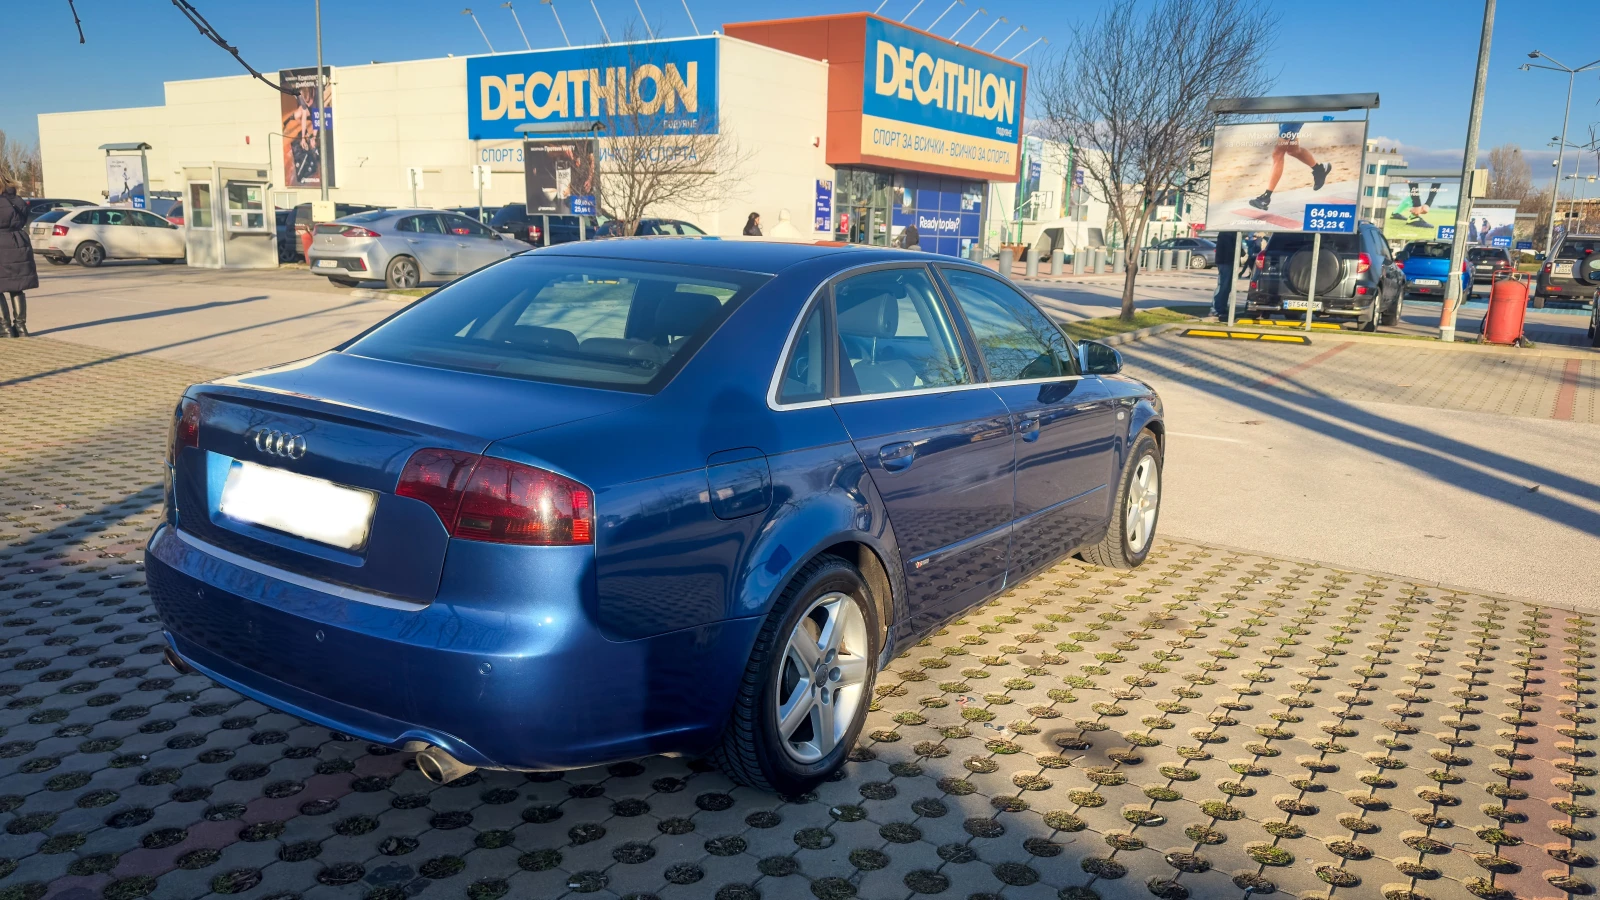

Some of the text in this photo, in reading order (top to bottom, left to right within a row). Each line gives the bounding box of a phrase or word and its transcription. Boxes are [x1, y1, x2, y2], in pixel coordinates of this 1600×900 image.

[876, 39, 1016, 125] DECATHLON
[480, 61, 698, 121] DECATHLON
[481, 148, 514, 162] СПОРТ
[516, 148, 525, 162] З
[649, 145, 697, 162] СПОРТА
[873, 128, 901, 148] СПОРТ
[902, 133, 912, 150] ЗА
[914, 135, 945, 155] ВСИЧКИ
[950, 142, 976, 160] ВСИЧКО
[978, 146, 986, 161] ЗА
[987, 148, 1010, 165] СПОРТА
[1310, 208, 1339, 219] 64,99
[919, 215, 960, 232] Ready to play?
[1310, 219, 1345, 230] 33,23 €
